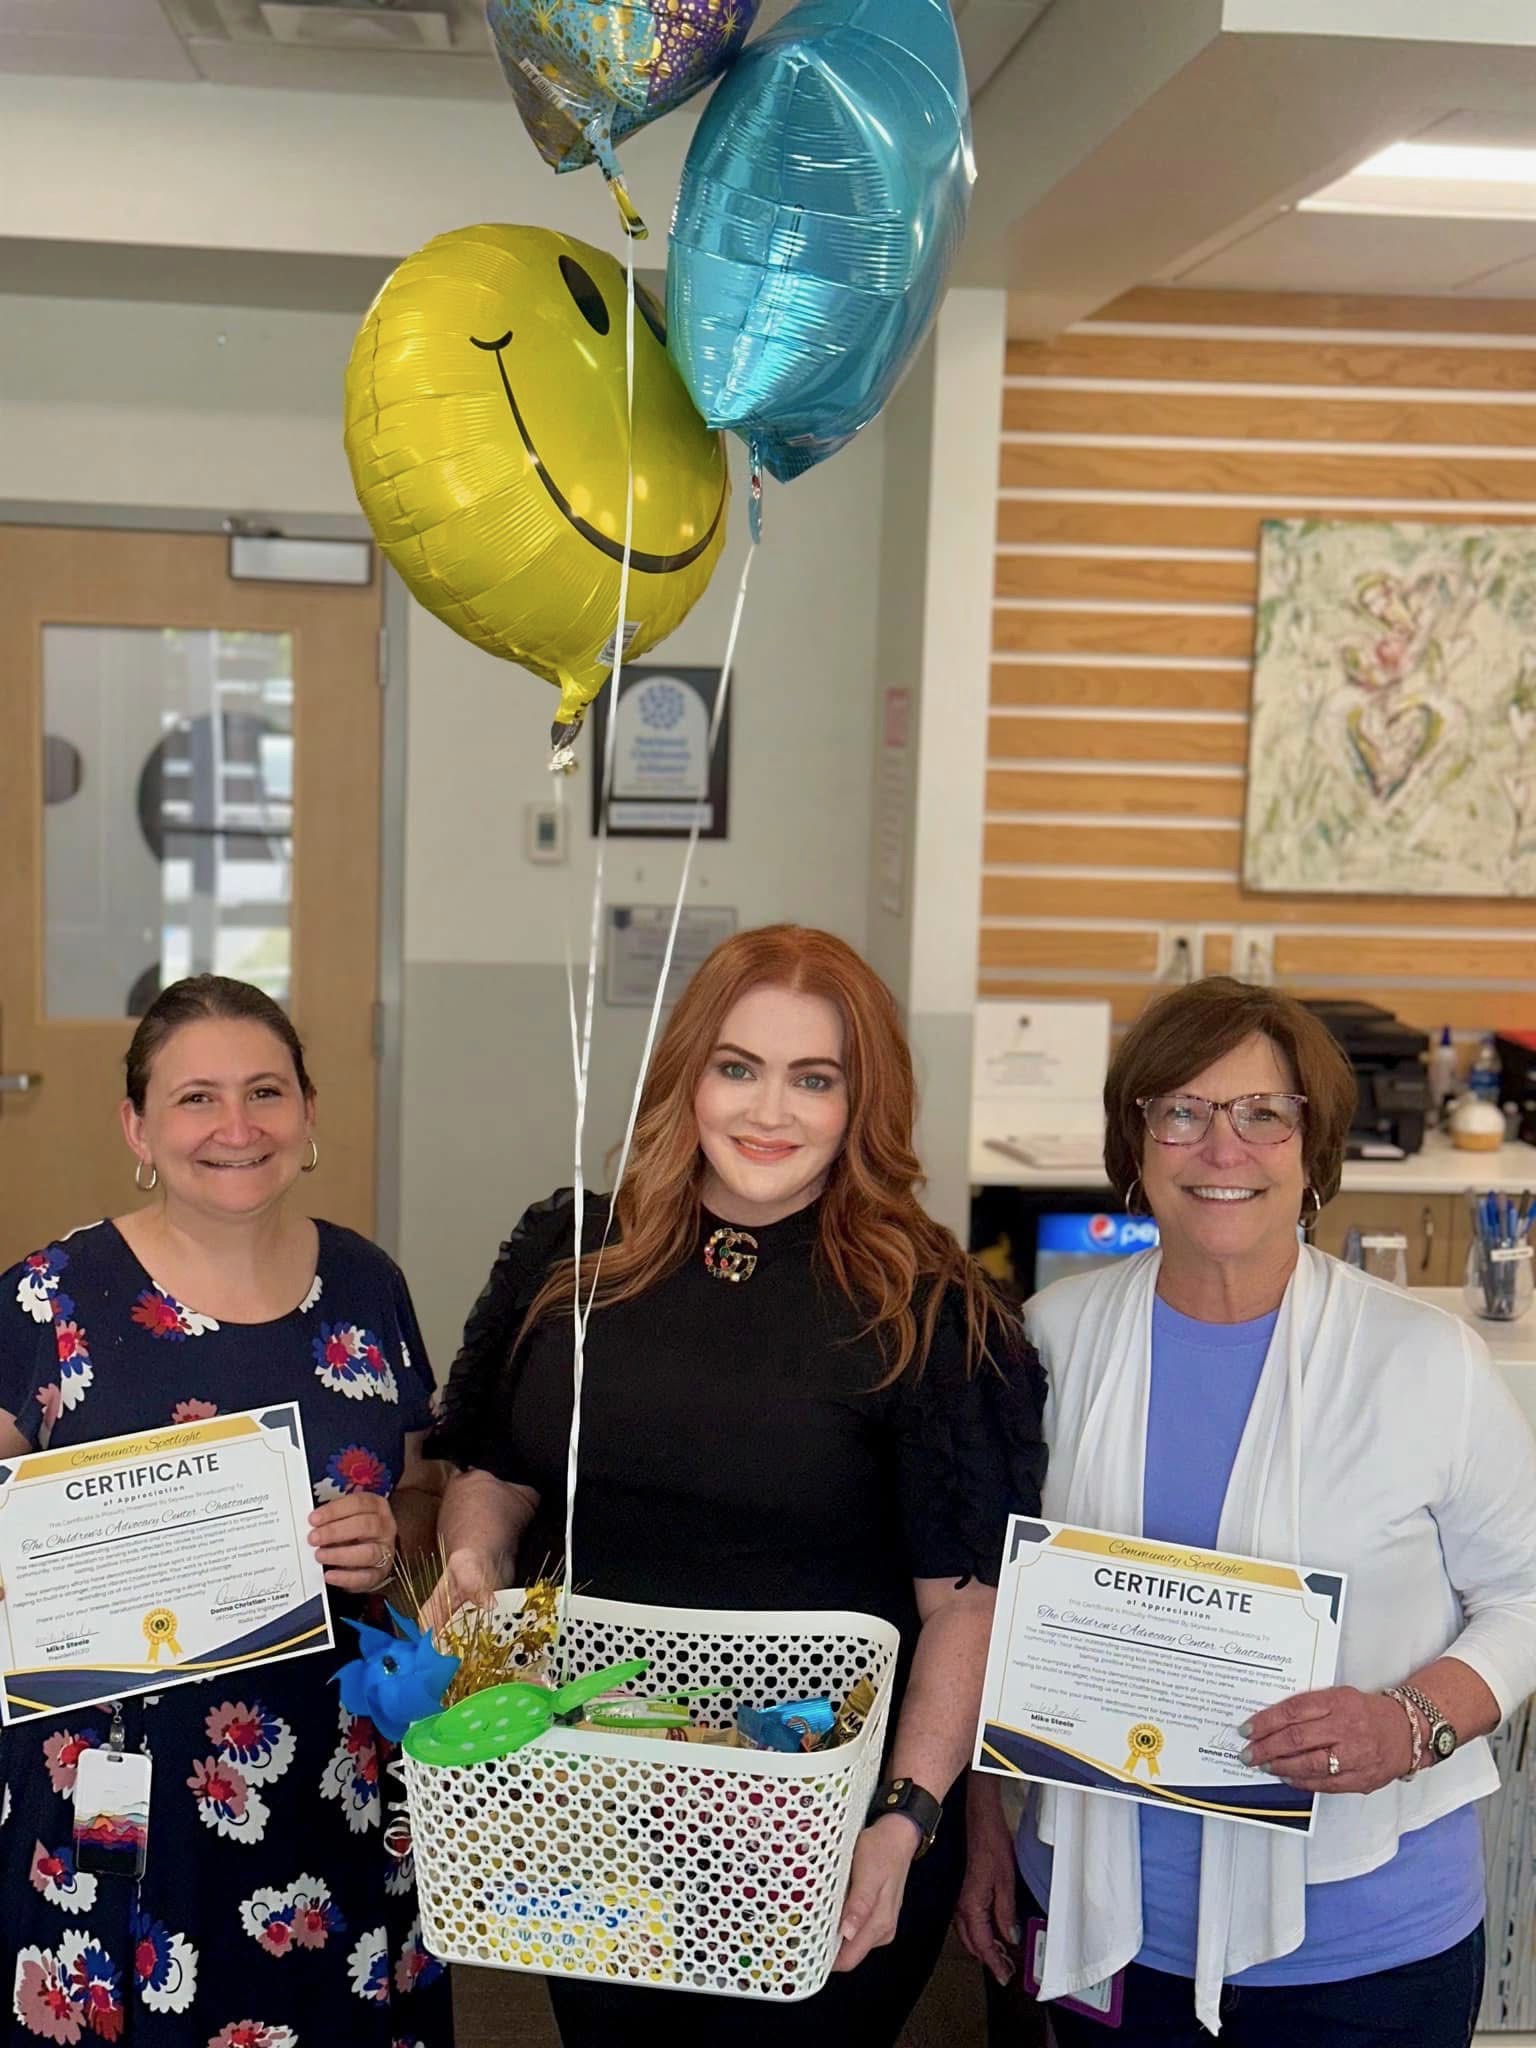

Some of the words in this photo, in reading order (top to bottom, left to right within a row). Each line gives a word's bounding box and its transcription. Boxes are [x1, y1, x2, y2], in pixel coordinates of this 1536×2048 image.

[70, 1444, 143, 1467] Community
[144, 1430, 202, 1451] Spotlight
[65, 1452, 219, 1500] CERTIFICATE
[102, 1498, 113, 1507] of
[116, 1483, 185, 1505] Appreciation
[21, 1538, 43, 1554] The
[45, 1528, 103, 1548] Children's
[161, 1508, 196, 1523] Center
[1108, 1539, 1182, 1567] Community
[1182, 1554, 1243, 1576] Spotlight
[209, 1604, 233, 1614] Donna
[233, 1596, 266, 1609] Christian
[1094, 1567, 1253, 1614] CERTIFICATE
[1125, 1597, 1136, 1606] of
[1140, 1600, 1211, 1622] Appreciation
[1036, 1604, 1059, 1620] The
[1060, 1610, 1118, 1631] Children's
[1119, 1623, 1177, 1645] Advocacy
[1177, 1633, 1215, 1650] Center
[45, 1643, 65, 1653] Mike
[1030, 1713, 1050, 1723] Mike
[1198, 1746, 1222, 1757] Donna
